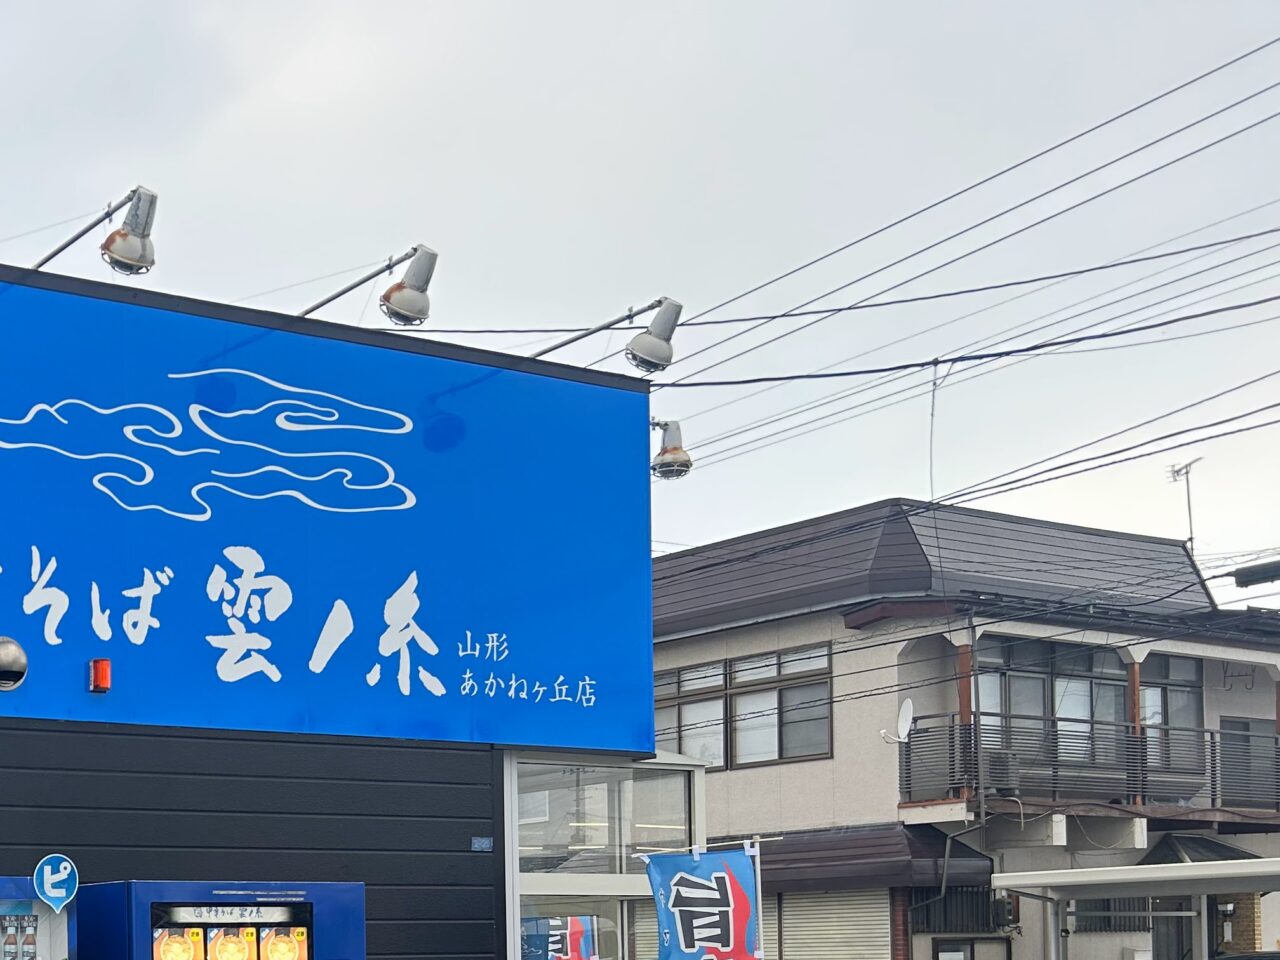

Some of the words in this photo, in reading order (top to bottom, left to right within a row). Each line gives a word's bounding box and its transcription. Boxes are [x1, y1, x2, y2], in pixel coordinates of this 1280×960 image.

[457, 630, 509, 661] 山形
[460, 668, 597, 708] あかねヶ丘店
[43, 861, 72, 898] ピ
